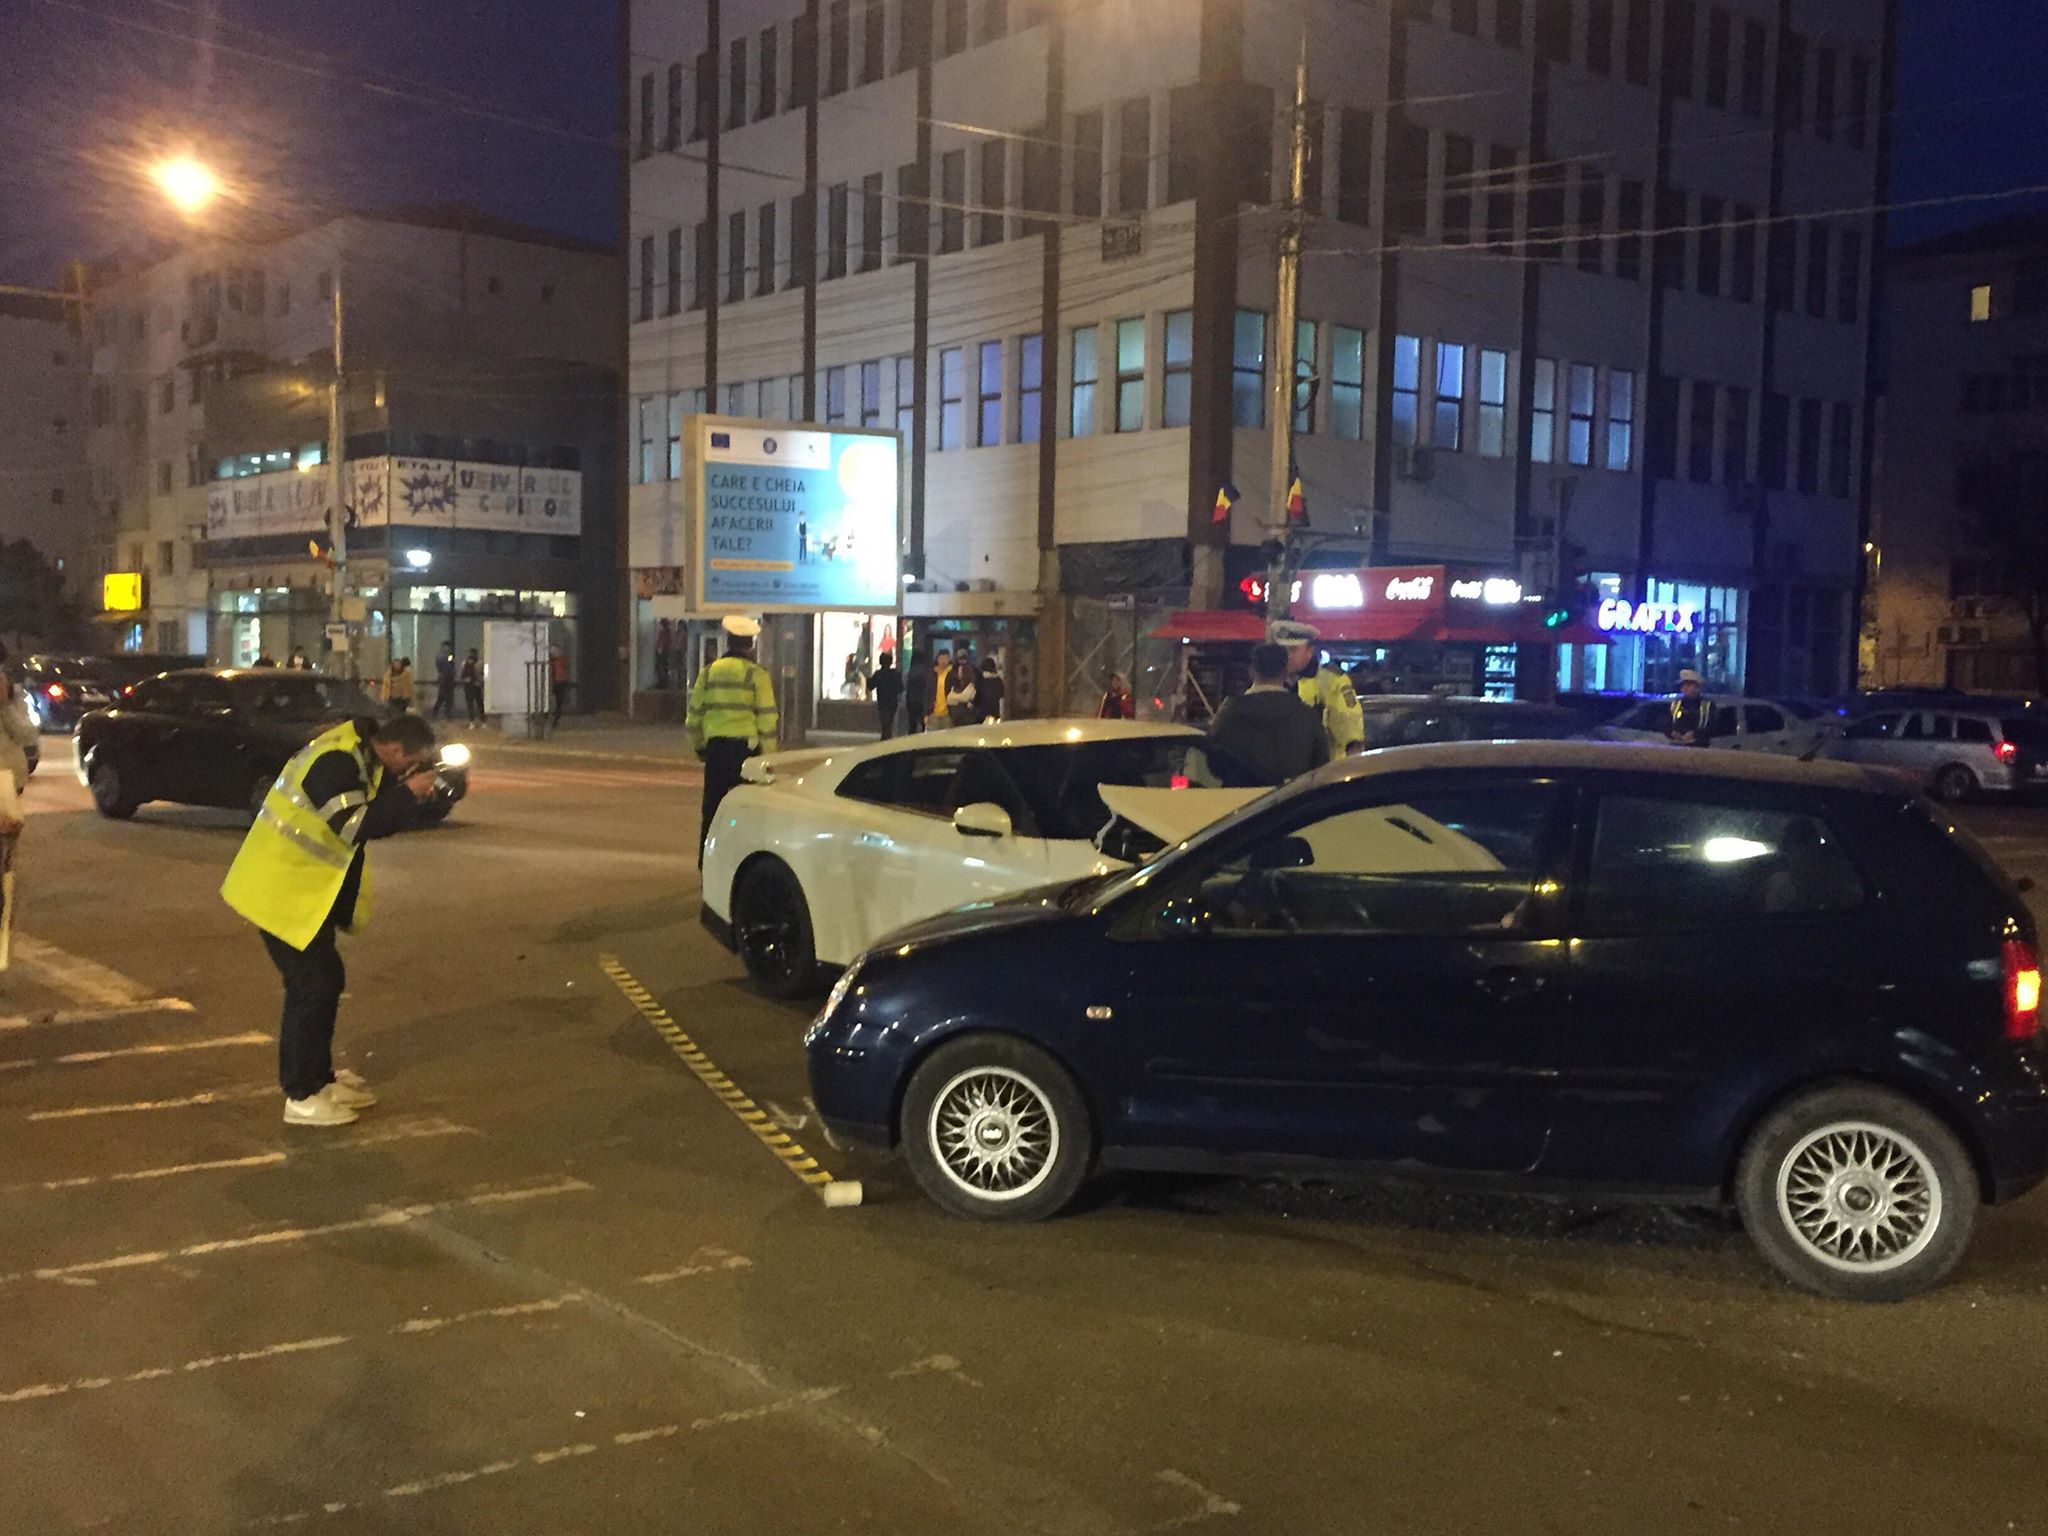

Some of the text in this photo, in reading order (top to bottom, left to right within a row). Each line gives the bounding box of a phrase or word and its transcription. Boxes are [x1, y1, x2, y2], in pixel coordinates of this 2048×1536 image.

[711, 474, 806, 493] CARE E CHEIA
[711, 495, 796, 513] SUCCESULUI
[711, 516, 774, 532] AFACERII
[711, 535, 753, 552] TALE?
[1598, 598, 1696, 632] GRAFIX
